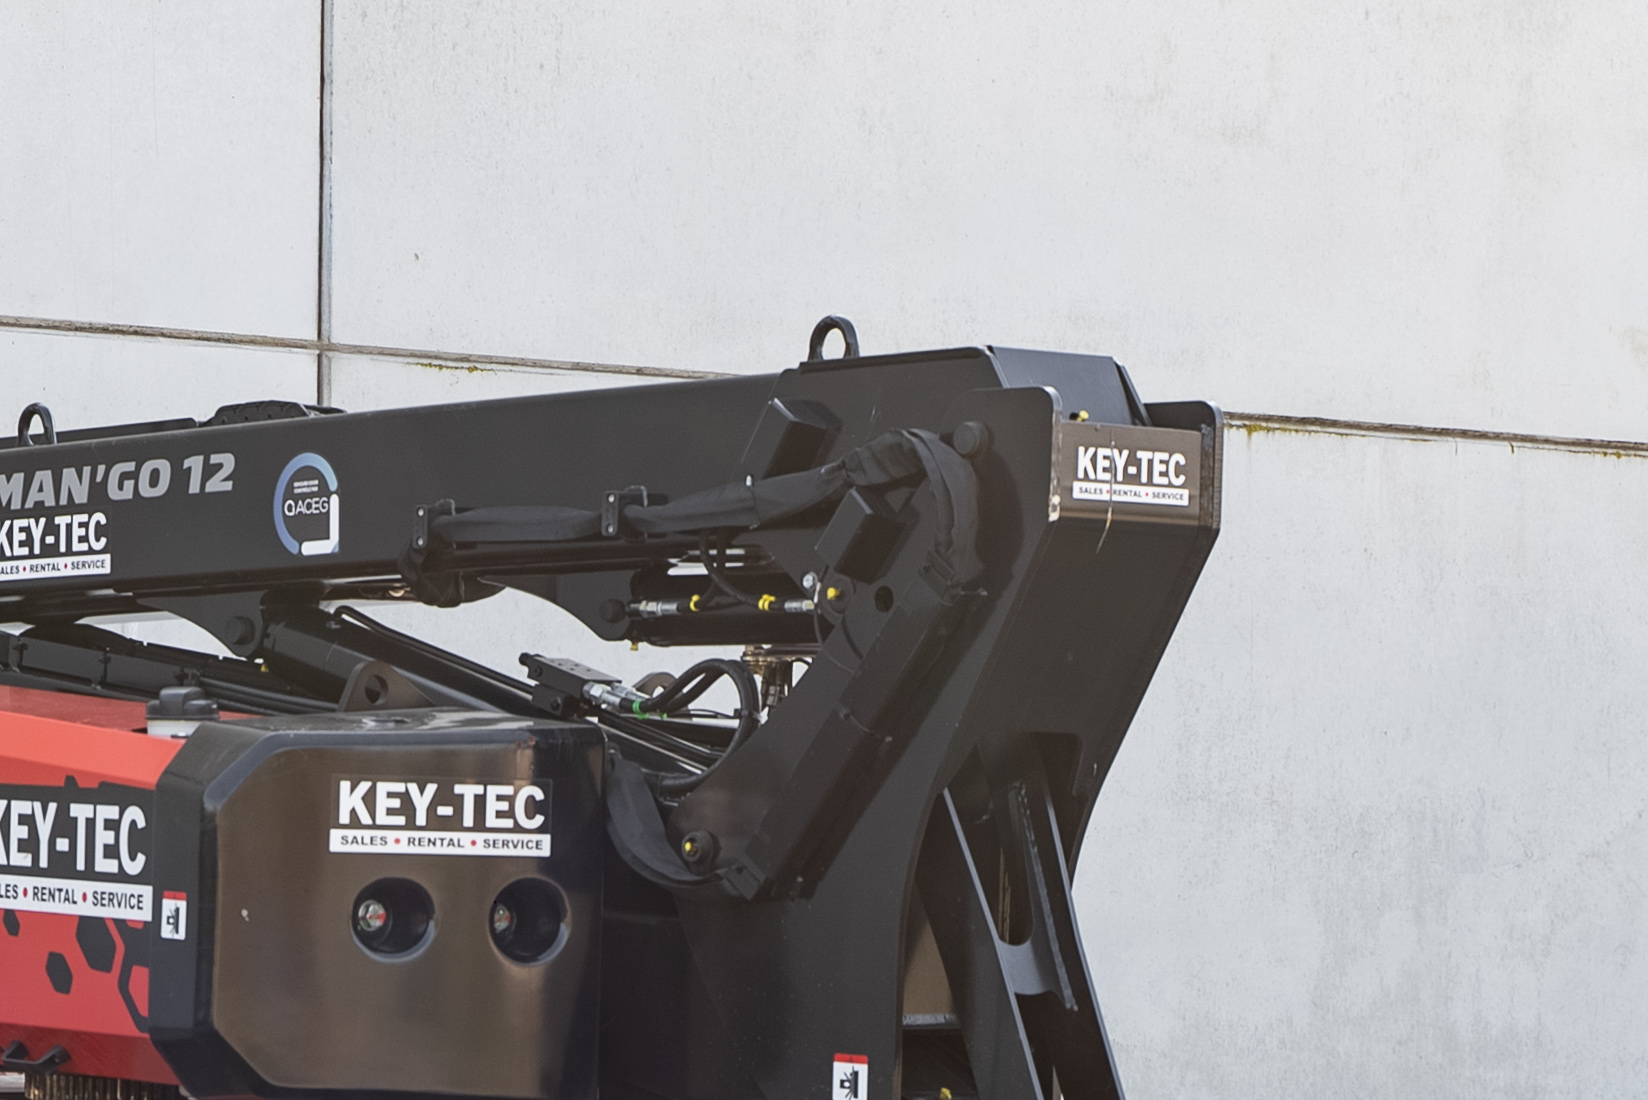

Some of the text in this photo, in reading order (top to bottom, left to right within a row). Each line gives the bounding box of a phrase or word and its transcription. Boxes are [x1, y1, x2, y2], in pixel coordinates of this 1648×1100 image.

[182, 452, 236, 495] 12
[1077, 446, 1186, 486] KEY-TEC
[1078, 486, 1185, 501] SALES RENTAL SERVICE
[29, 562, 61, 573] RENTAL
[70, 559, 106, 571] SERVICE
[338, 780, 546, 830] KEY-TEC
[340, 835, 544, 851] SALES RENTAL SERVICE
[32, 885, 78, 906] RENTAL
[91, 890, 145, 911] SERVICE
